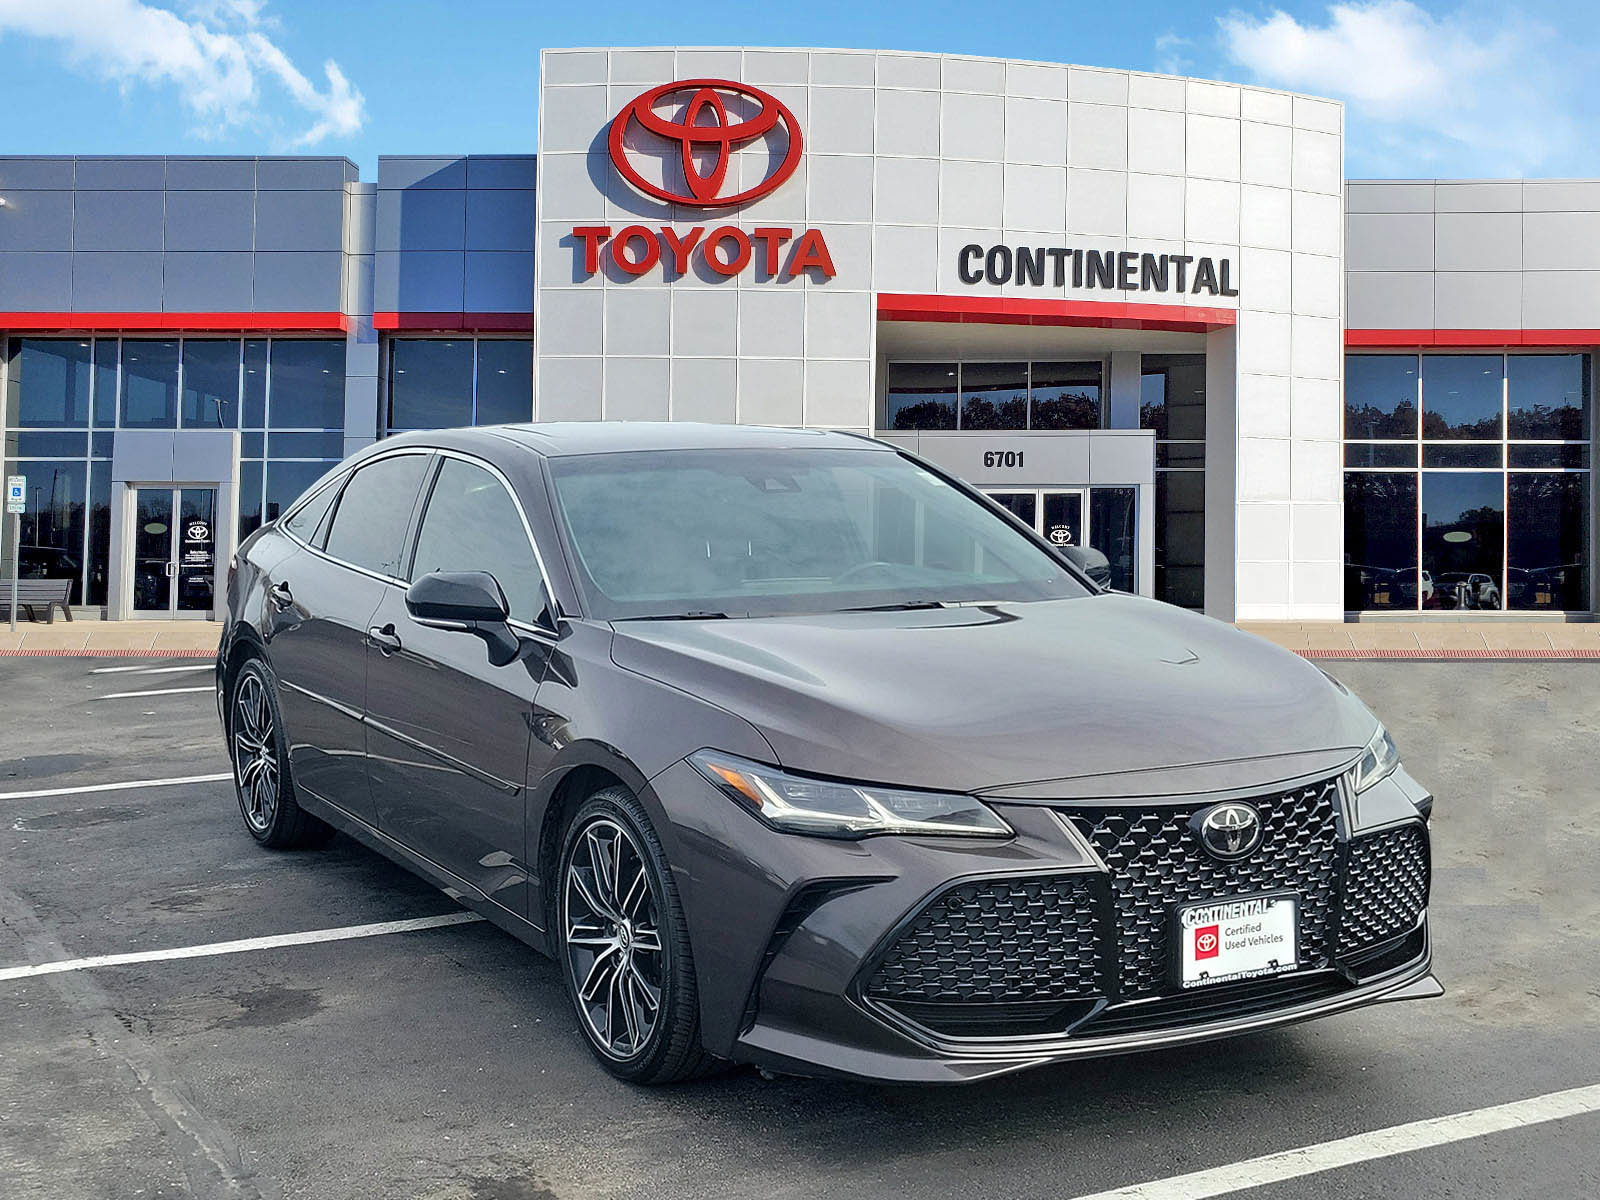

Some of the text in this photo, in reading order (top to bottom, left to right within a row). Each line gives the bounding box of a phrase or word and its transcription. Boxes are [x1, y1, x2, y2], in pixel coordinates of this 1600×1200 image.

[572, 225, 837, 277] TOYOTA
[958, 244, 1239, 297] CONTINENTAL
[983, 451, 1024, 468] 6701
[1183, 899, 1269, 927] CONTINENTAL
[1225, 922, 1262, 937] Certified
[1225, 933, 1284, 950] Used Vehicles
[1182, 963, 1298, 989] ContinentalToyota.com
